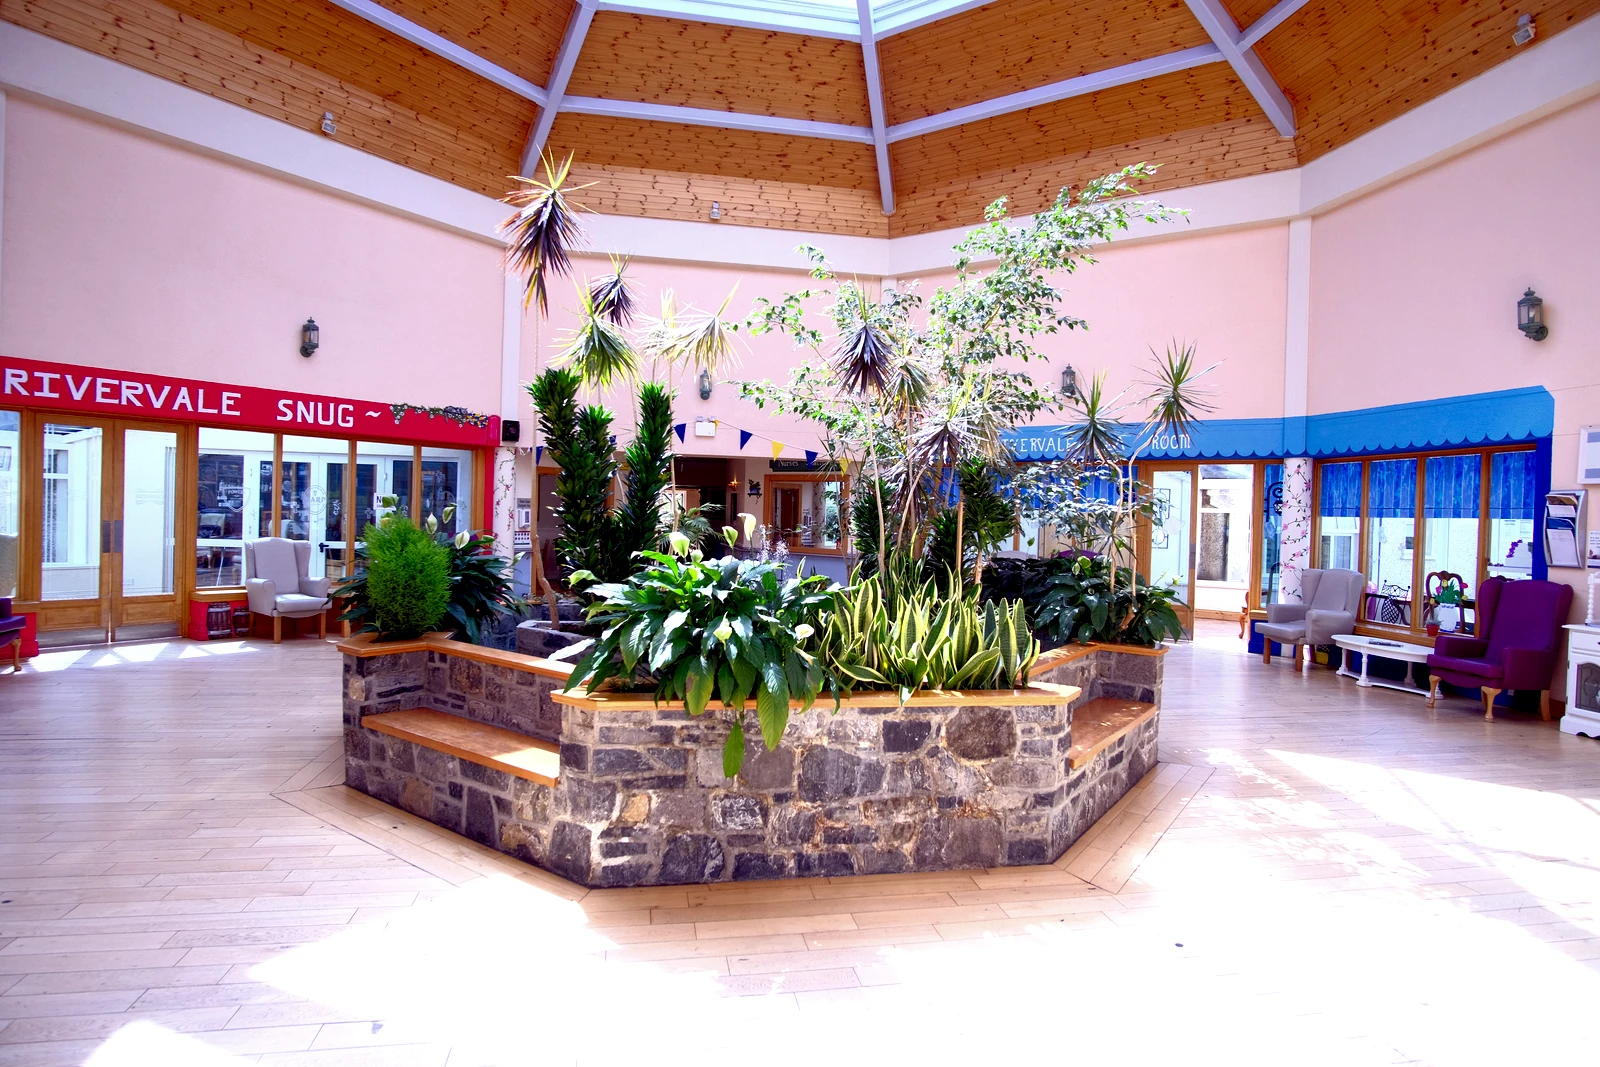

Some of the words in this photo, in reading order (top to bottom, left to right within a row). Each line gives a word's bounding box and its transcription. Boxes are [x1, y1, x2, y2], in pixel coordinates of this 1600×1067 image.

[4, 368, 242, 416] RIVERVALE
[276, 399, 354, 428] SNUG
[1001, 437, 1074, 452] IVERVALE
